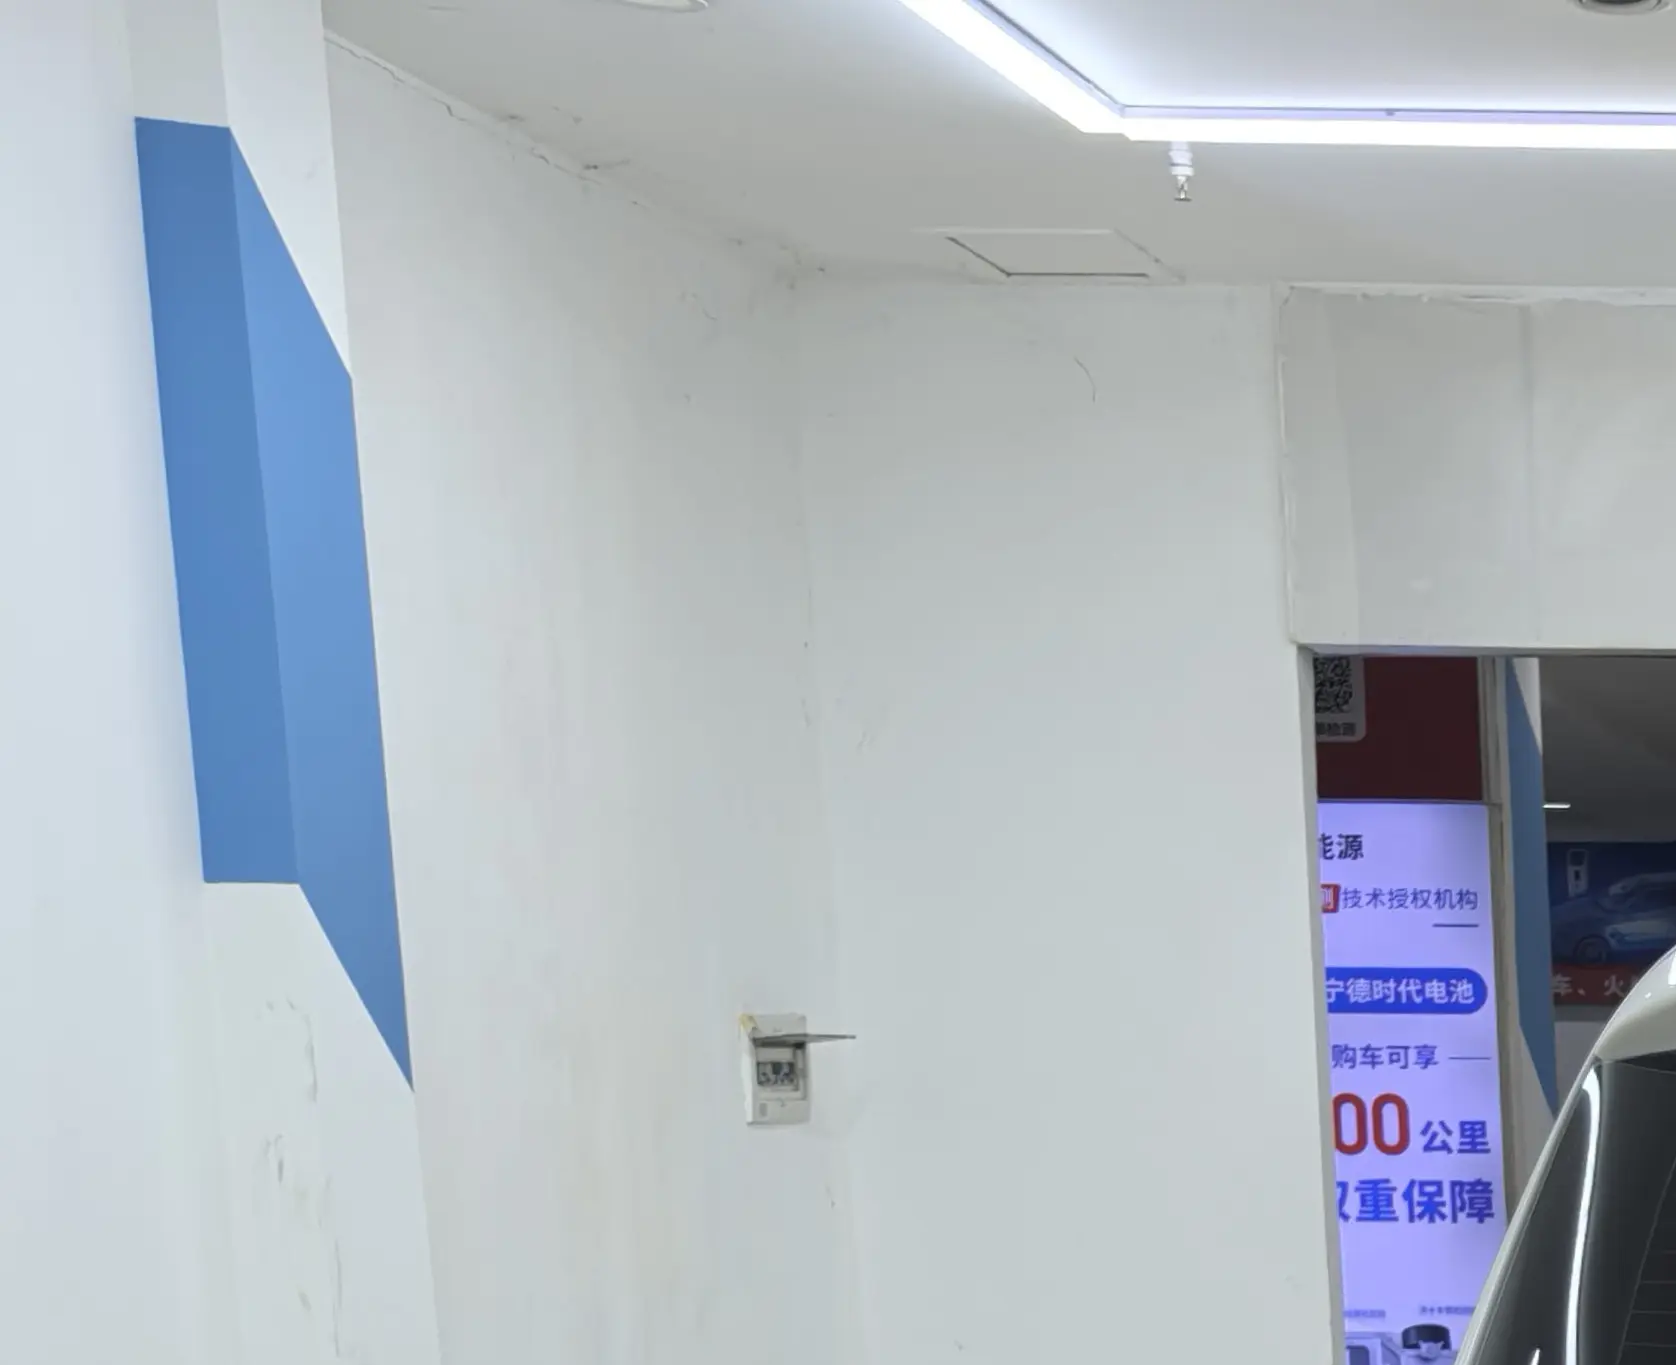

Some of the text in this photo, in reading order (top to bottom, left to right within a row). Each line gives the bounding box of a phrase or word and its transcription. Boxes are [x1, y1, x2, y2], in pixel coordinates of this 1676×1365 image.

[1342, 887, 1479, 911] 技术授权机构
[1326, 977, 1476, 1005] 宁德时代电池
[1331, 1043, 1440, 1070] 购车可享
[1420, 1119, 1492, 1155] 公里
